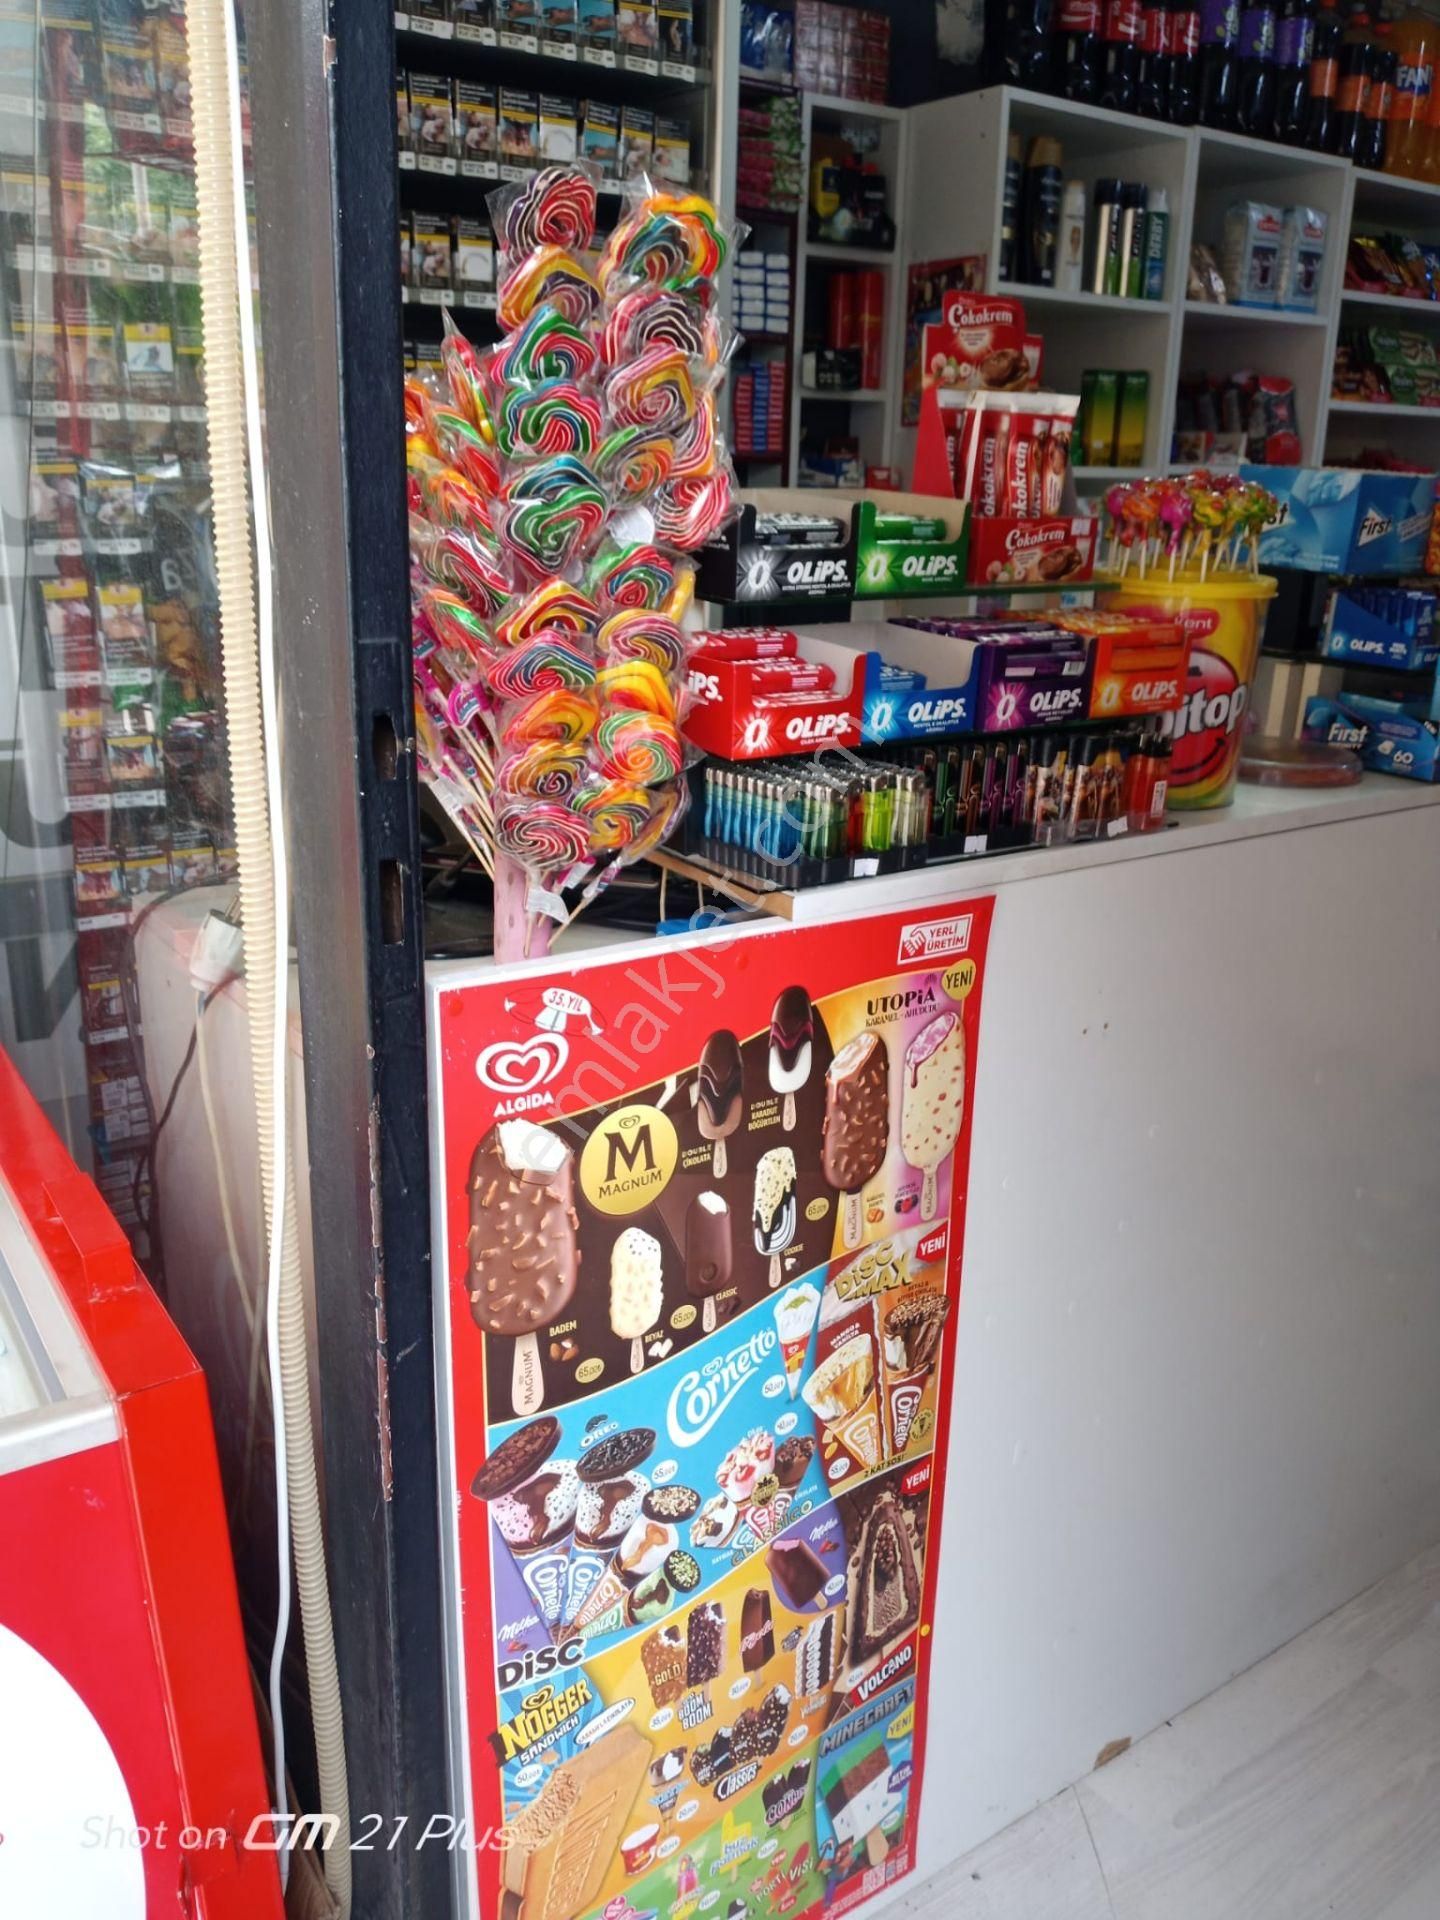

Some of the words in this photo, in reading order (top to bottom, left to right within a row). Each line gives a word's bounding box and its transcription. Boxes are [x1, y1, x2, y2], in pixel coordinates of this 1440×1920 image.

[1397, 68, 1431, 86] FAN
[948, 305, 1014, 332] Çokokrem
[983, 437, 997, 518] okokrem
[1011, 441, 1029, 519] okokrem
[1358, 514, 1392, 538] First
[1005, 528, 1066, 556] Çokokrem
[1328, 721, 1368, 743] First
[1393, 750, 1413, 766] 60
[926, 935, 965, 951] ÜRETİM
[929, 922, 958, 938] YERLİ
[945, 968, 973, 990] YENİ
[493, 1090, 555, 1118] ALGIDA
[603, 1123, 657, 1182] M
[598, 1169, 663, 1200] MAGNUM
[920, 1236, 946, 1256] YENİ
[549, 1320, 577, 1338] BADEM
[523, 1350, 535, 1406] MAGNUM
[667, 1327, 777, 1448] Cornetto
[891, 1385, 922, 1448] Cornetto
[870, 1461, 886, 1476] KAT
[905, 1464, 931, 1490] YENİ
[522, 1553, 569, 1620] Cornetto
[567, 1554, 603, 1620] Cornetto
[497, 1614, 540, 1642] Milka
[497, 1636, 586, 1690] DiSC
[655, 1663, 681, 1687] GOLD
[857, 1645, 912, 1701] VOLCANO
[498, 1678, 593, 1760] NOGGER
[678, 1694, 704, 1720] BOOM
[681, 1705, 712, 1731] BOOM
[819, 1683, 915, 1757] MINECRAFT
[890, 1714, 912, 1736] YENİ
[520, 1715, 580, 1766] SANDWICH
[714, 1762, 759, 1800] Classics
